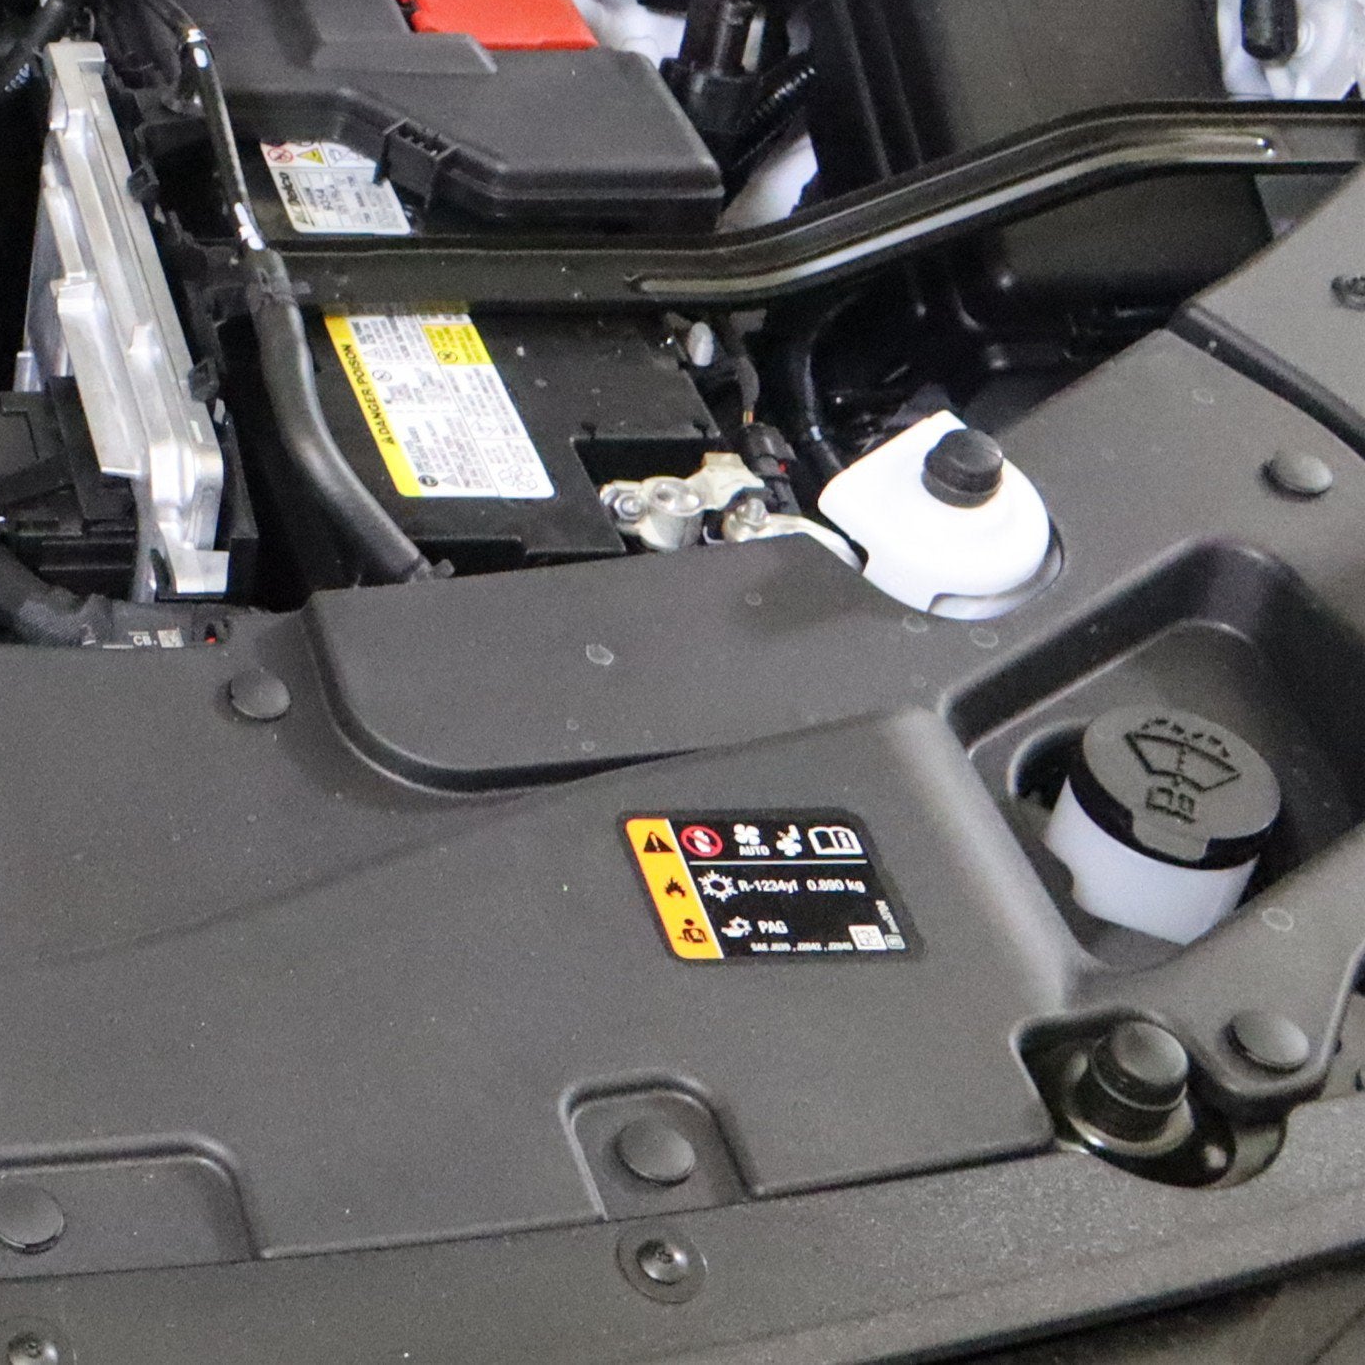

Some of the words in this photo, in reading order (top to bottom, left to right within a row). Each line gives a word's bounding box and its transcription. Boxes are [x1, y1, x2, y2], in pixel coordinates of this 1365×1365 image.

[739, 845, 770, 857] AUTO
[846, 880, 866, 894] kg
[757, 920, 789, 935] PAG
